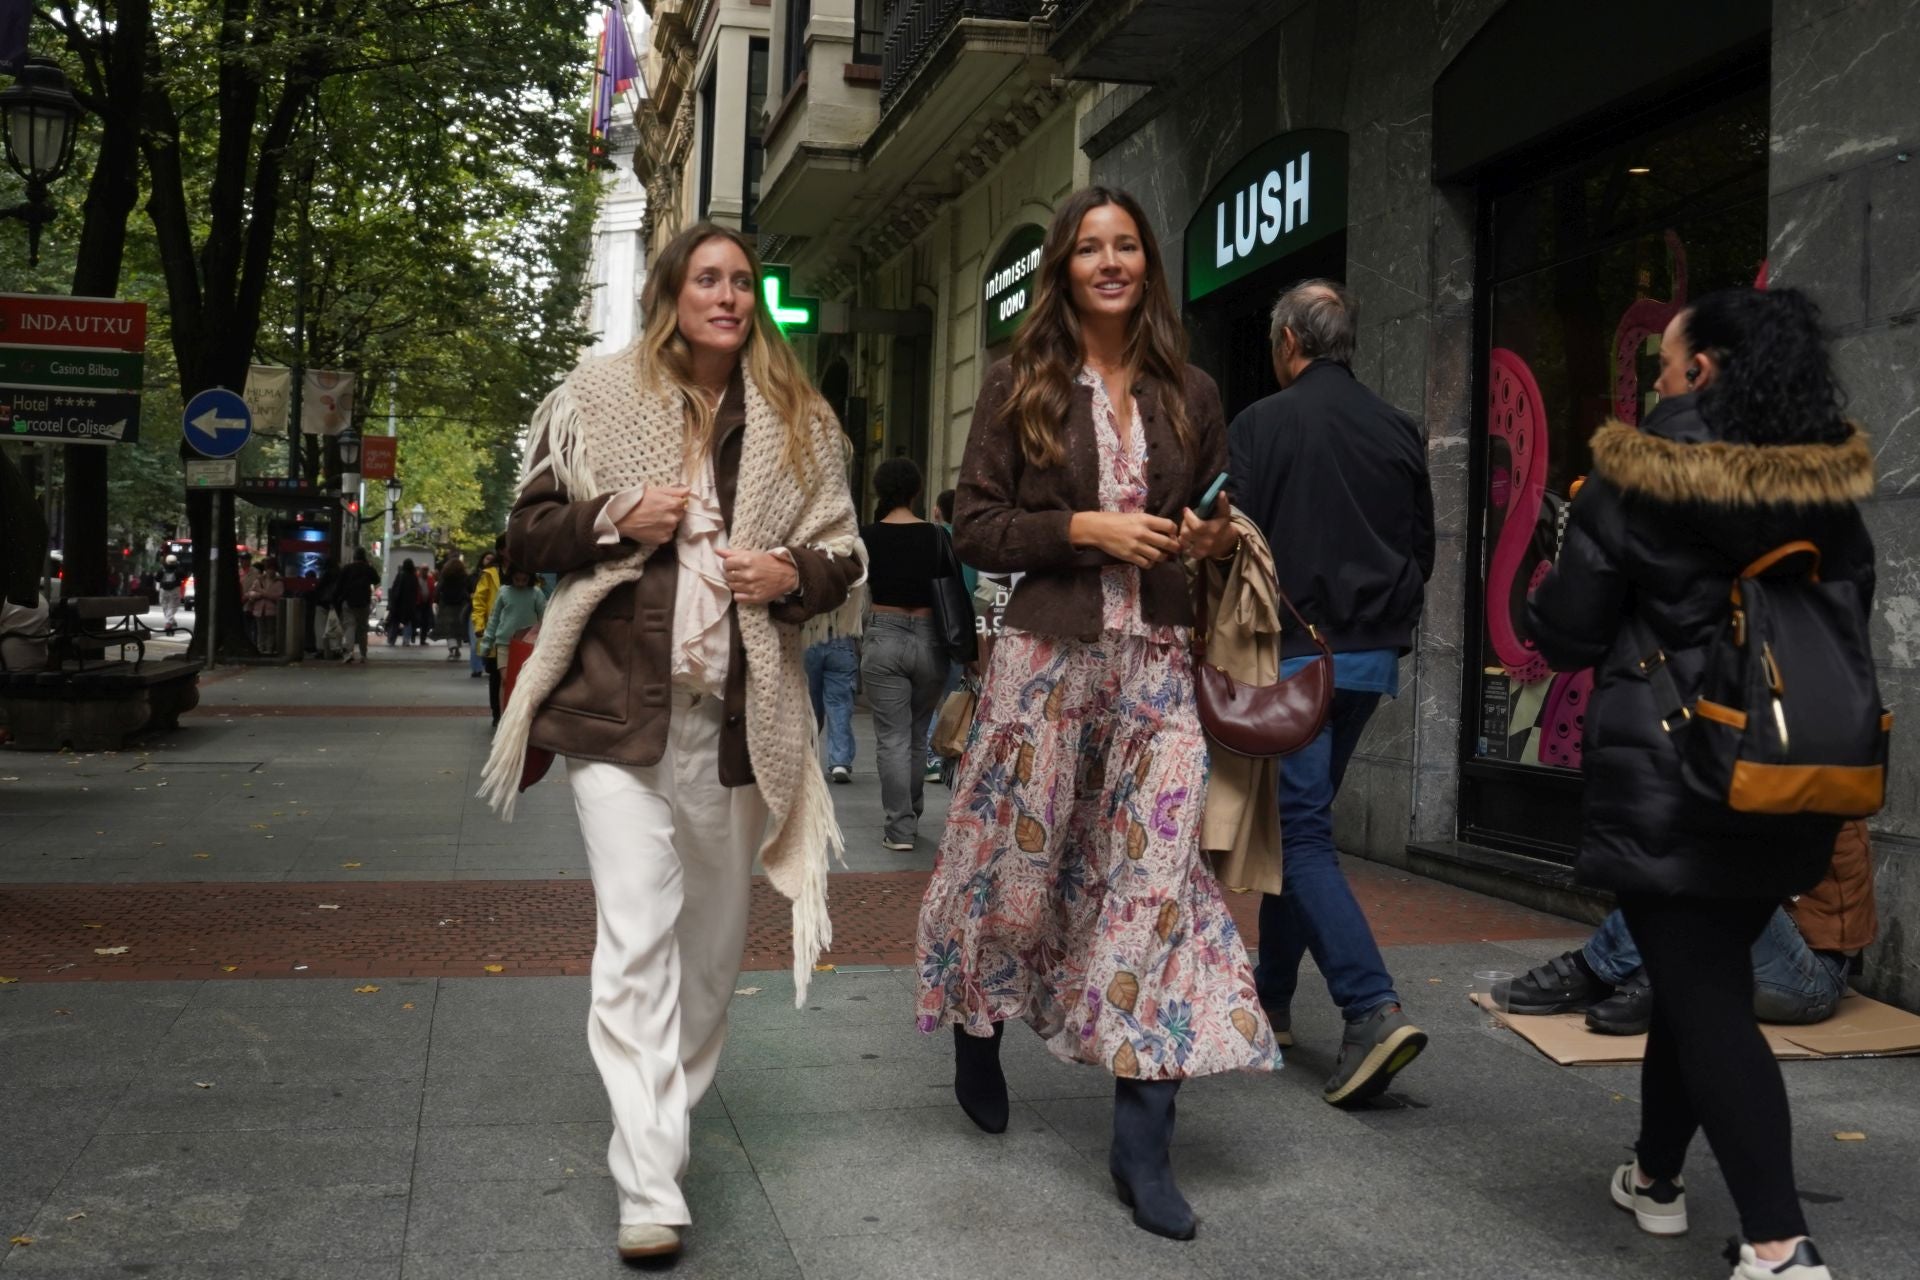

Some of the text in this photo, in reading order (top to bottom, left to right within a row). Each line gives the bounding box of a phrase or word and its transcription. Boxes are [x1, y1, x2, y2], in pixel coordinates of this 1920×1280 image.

[1216, 151, 1310, 269] LUSH
[1000, 289, 1026, 321] UOMO
[20, 313, 133, 334] INDAUTXU
[50, 361, 120, 377] Casino Bilbao
[13, 394, 49, 411] Hotel
[247, 387, 282, 399] HILMA
[13, 414, 63, 433] Srcotel
